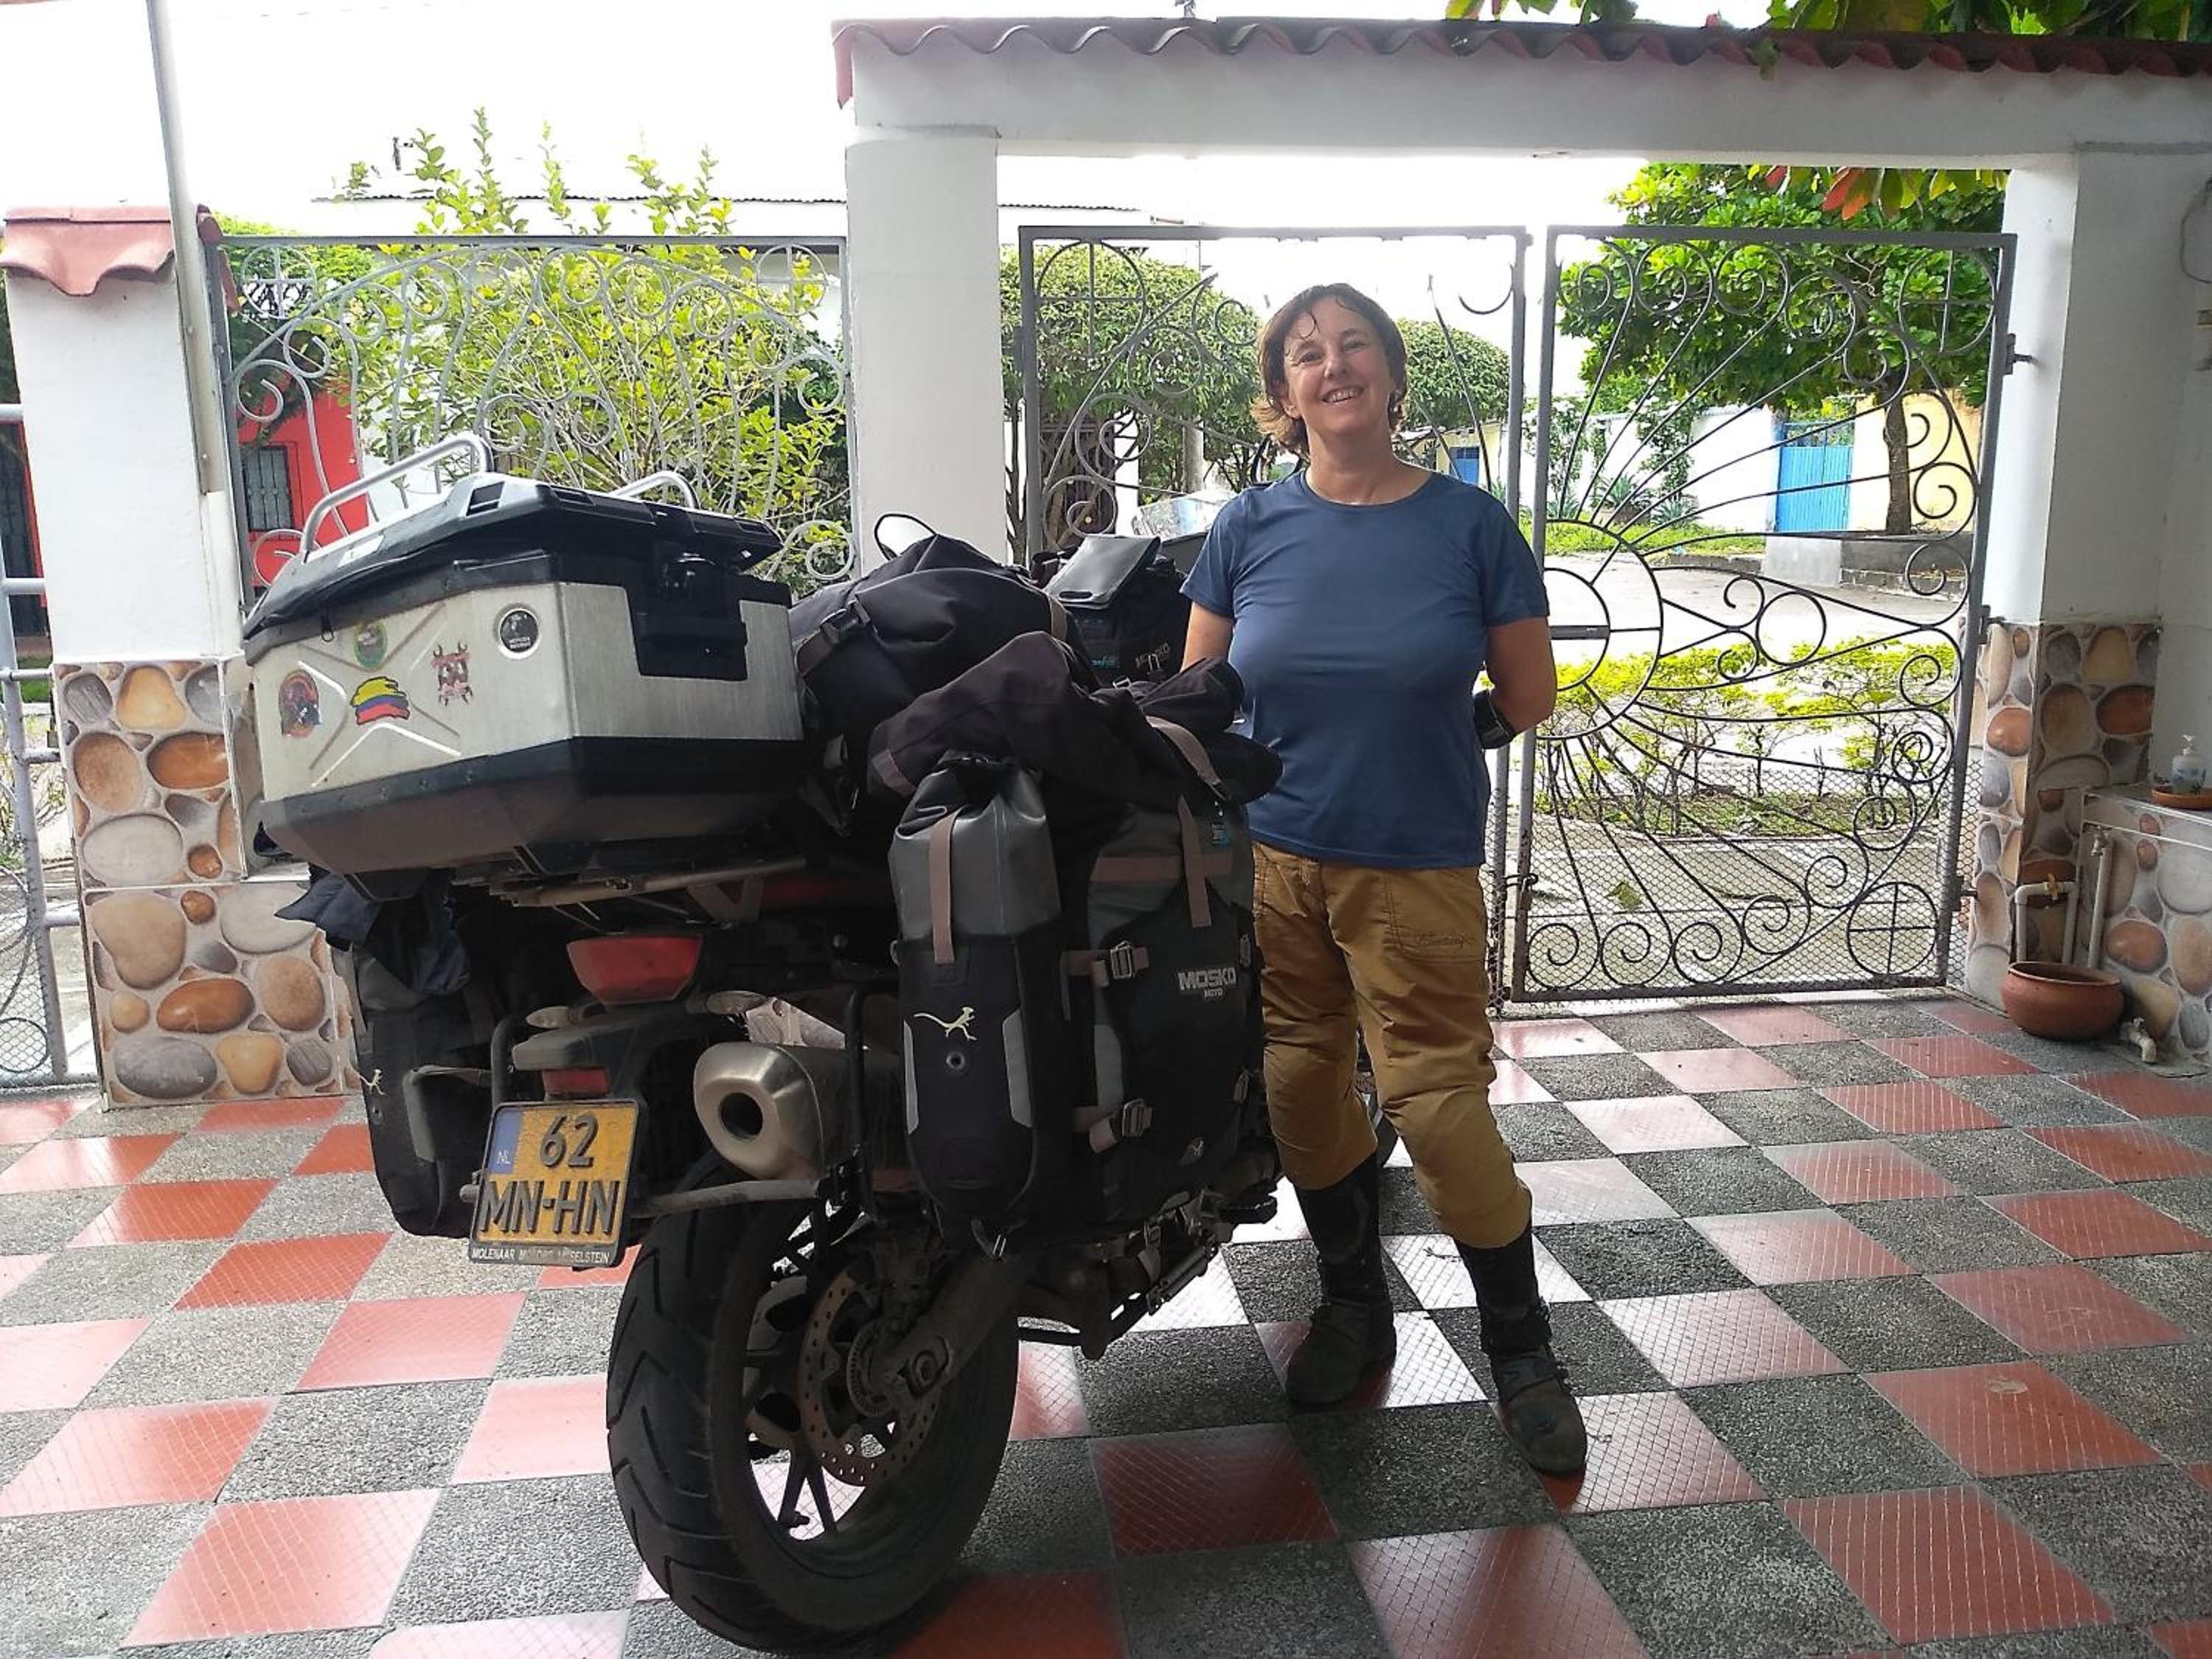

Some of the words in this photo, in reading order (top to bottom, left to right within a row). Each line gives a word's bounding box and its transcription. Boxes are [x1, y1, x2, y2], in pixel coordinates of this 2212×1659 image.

[1178, 967, 1236, 990] MOSKO
[496, 1151, 510, 1164] NL
[541, 1112, 598, 1167] 62
[479, 1180, 620, 1234] MN-HN
